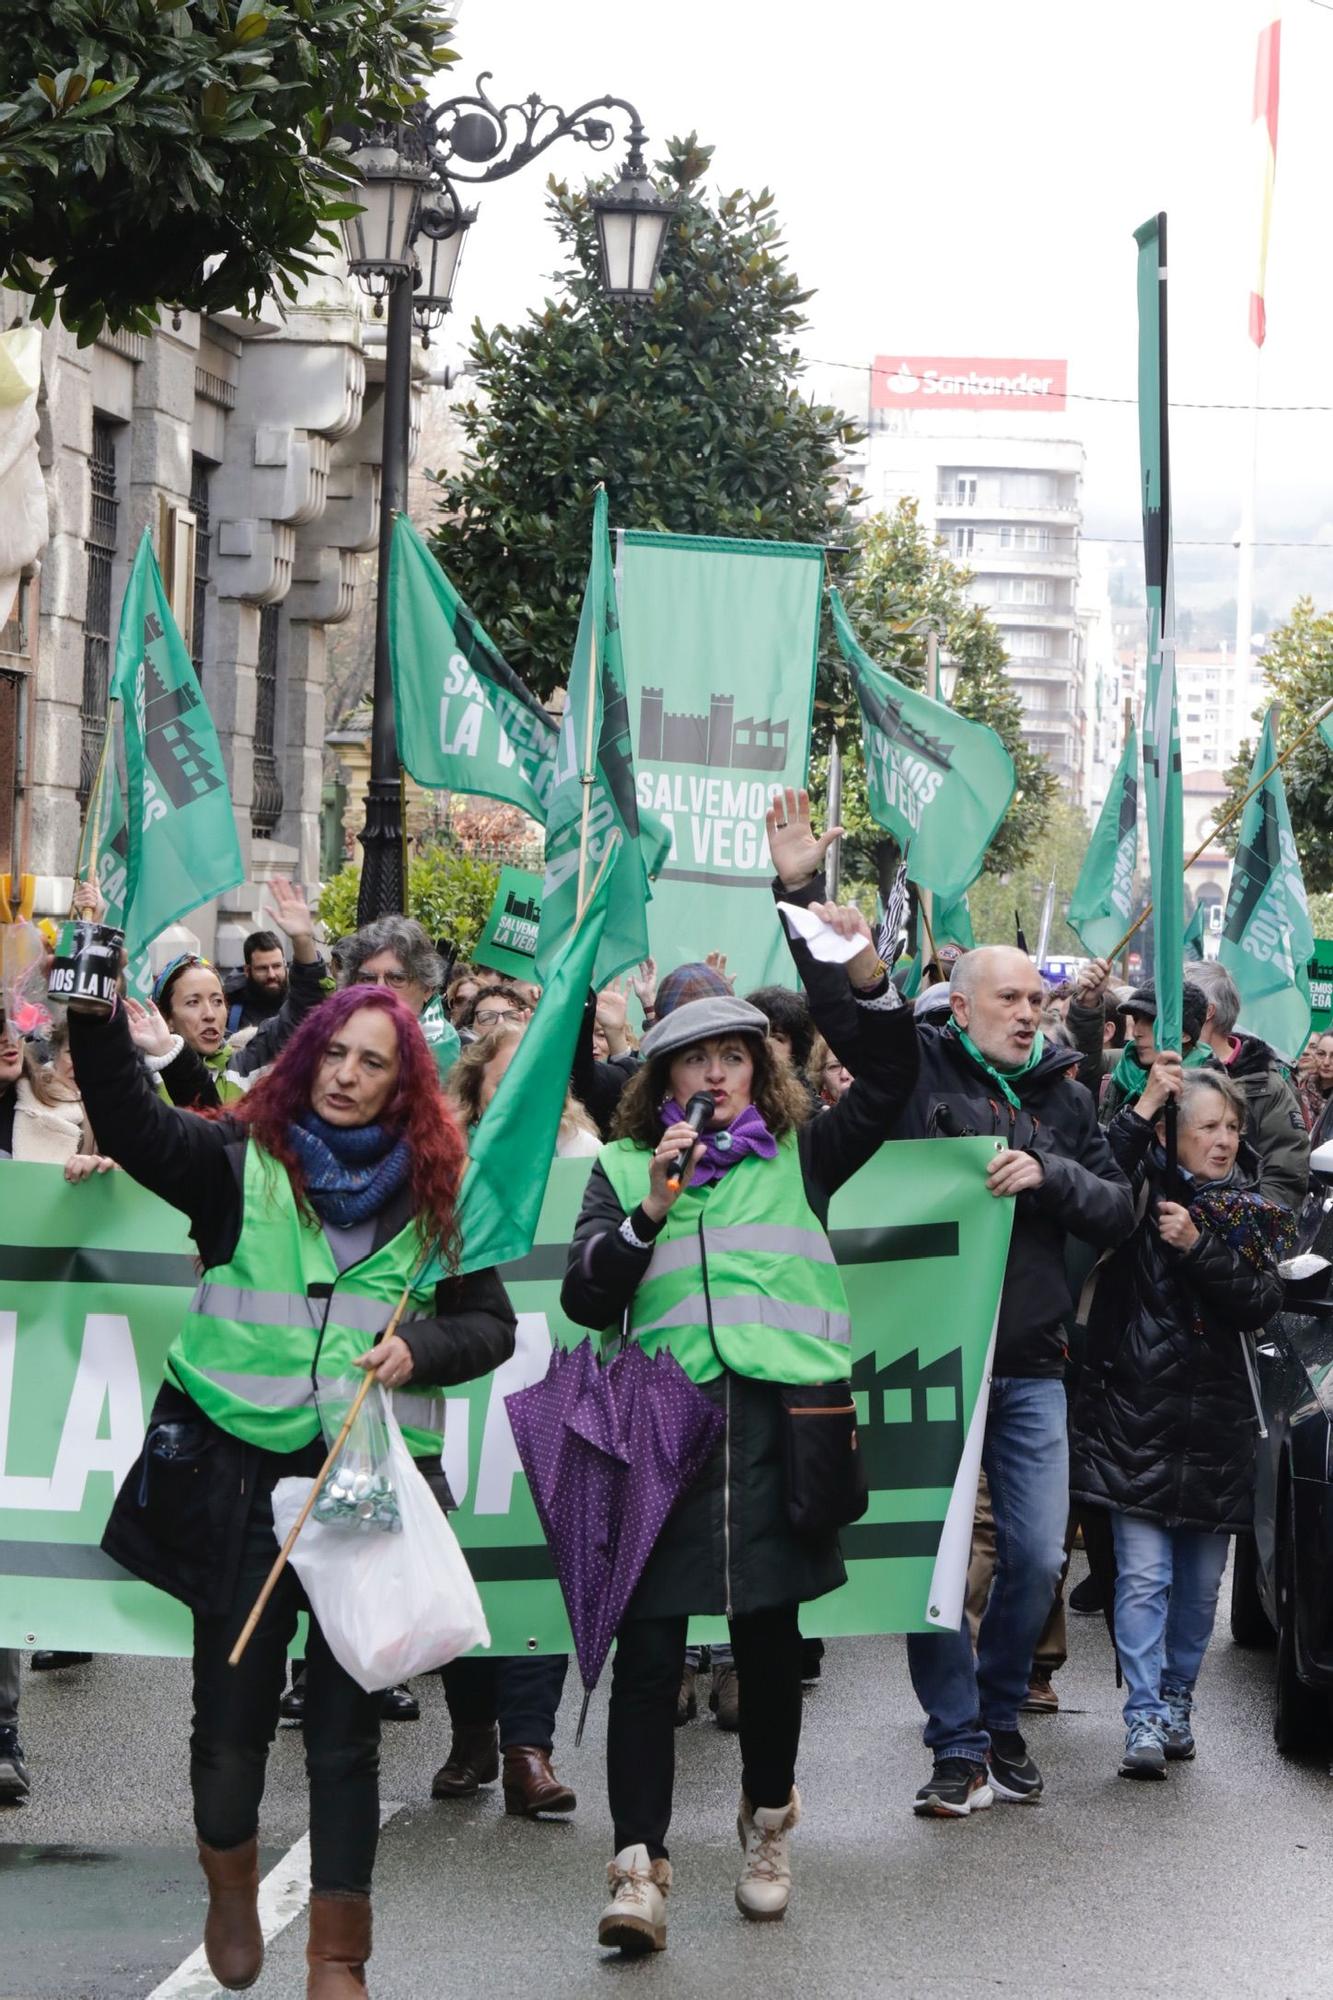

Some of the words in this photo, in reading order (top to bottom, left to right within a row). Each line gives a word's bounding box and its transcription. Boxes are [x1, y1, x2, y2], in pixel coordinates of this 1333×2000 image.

[921, 369, 1053, 396] Santander
[439, 697, 484, 757] LA
[493, 927, 510, 943] LA
[78, 971, 99, 996] LA
[1309, 981, 1333, 994] EMOS
[1310, 993, 1332, 1008] EGA
